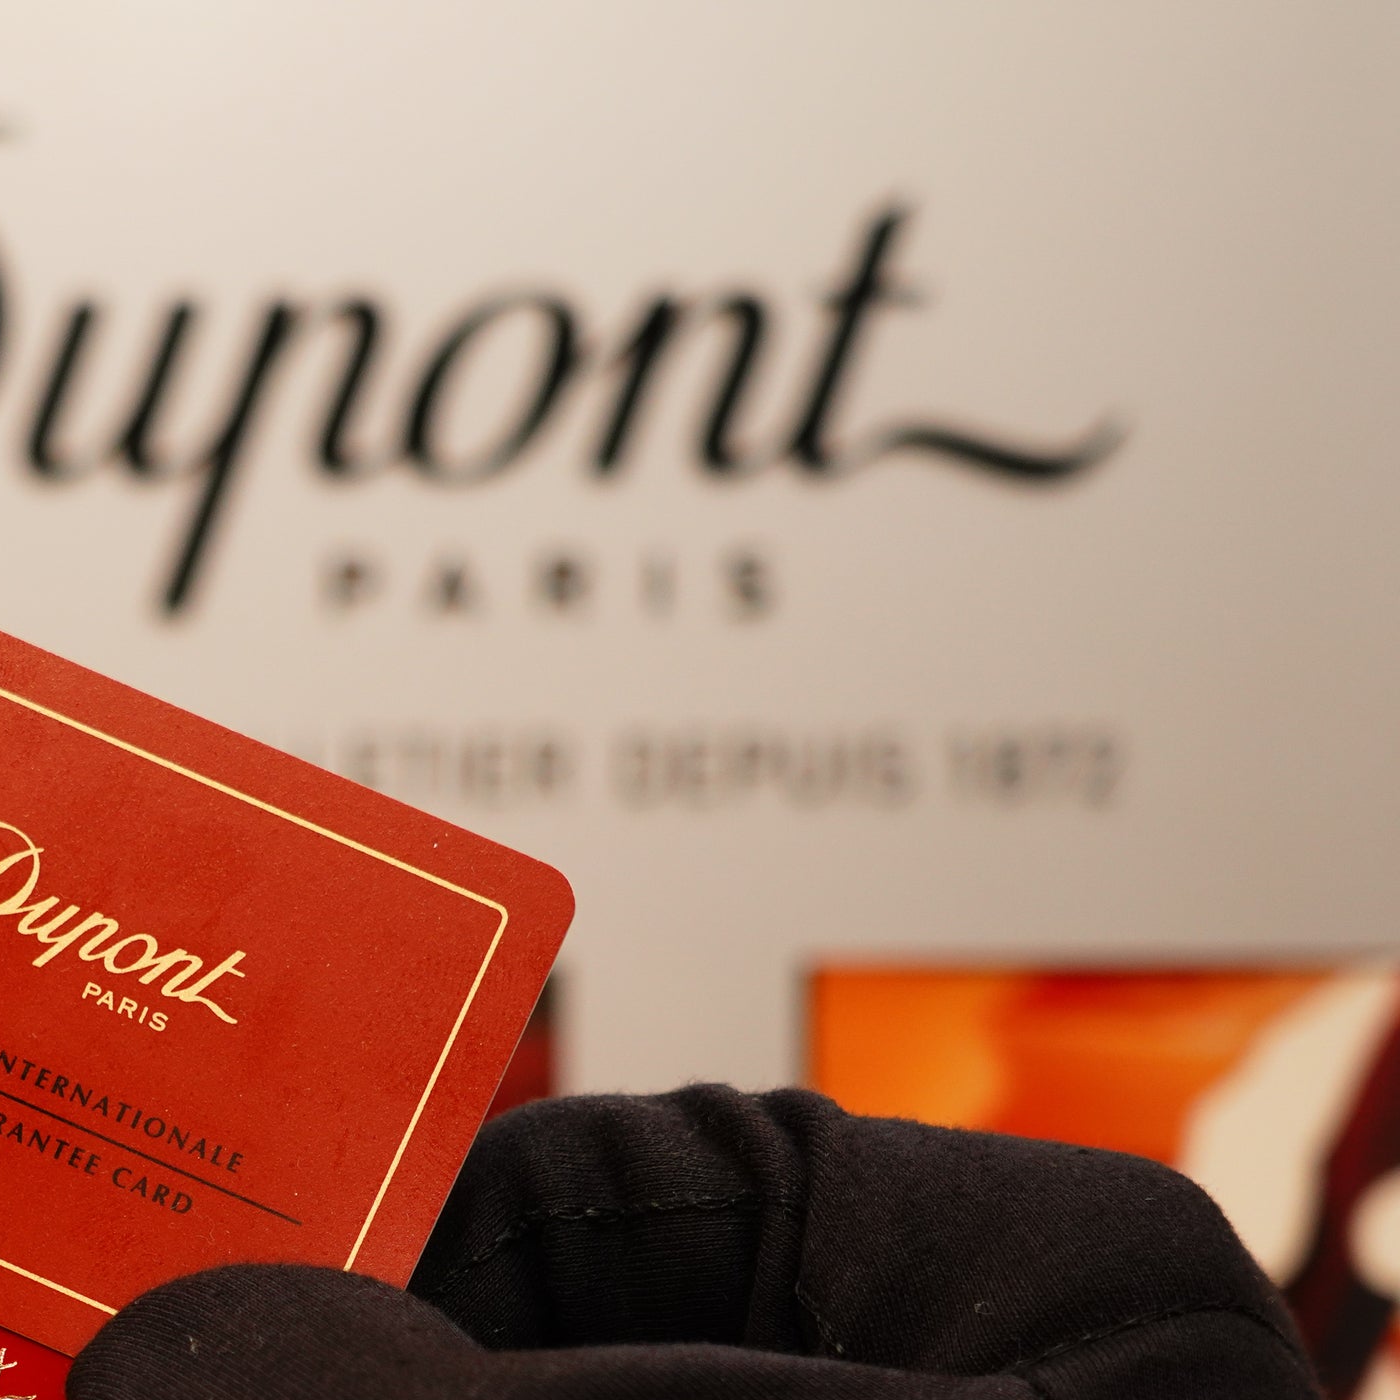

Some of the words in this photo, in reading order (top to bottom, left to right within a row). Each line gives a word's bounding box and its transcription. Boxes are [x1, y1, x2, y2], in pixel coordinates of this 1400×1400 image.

[319, 545, 782, 620] PARIS
[80, 980, 170, 1033] PARIS
[110, 1166, 195, 1215] CARD
